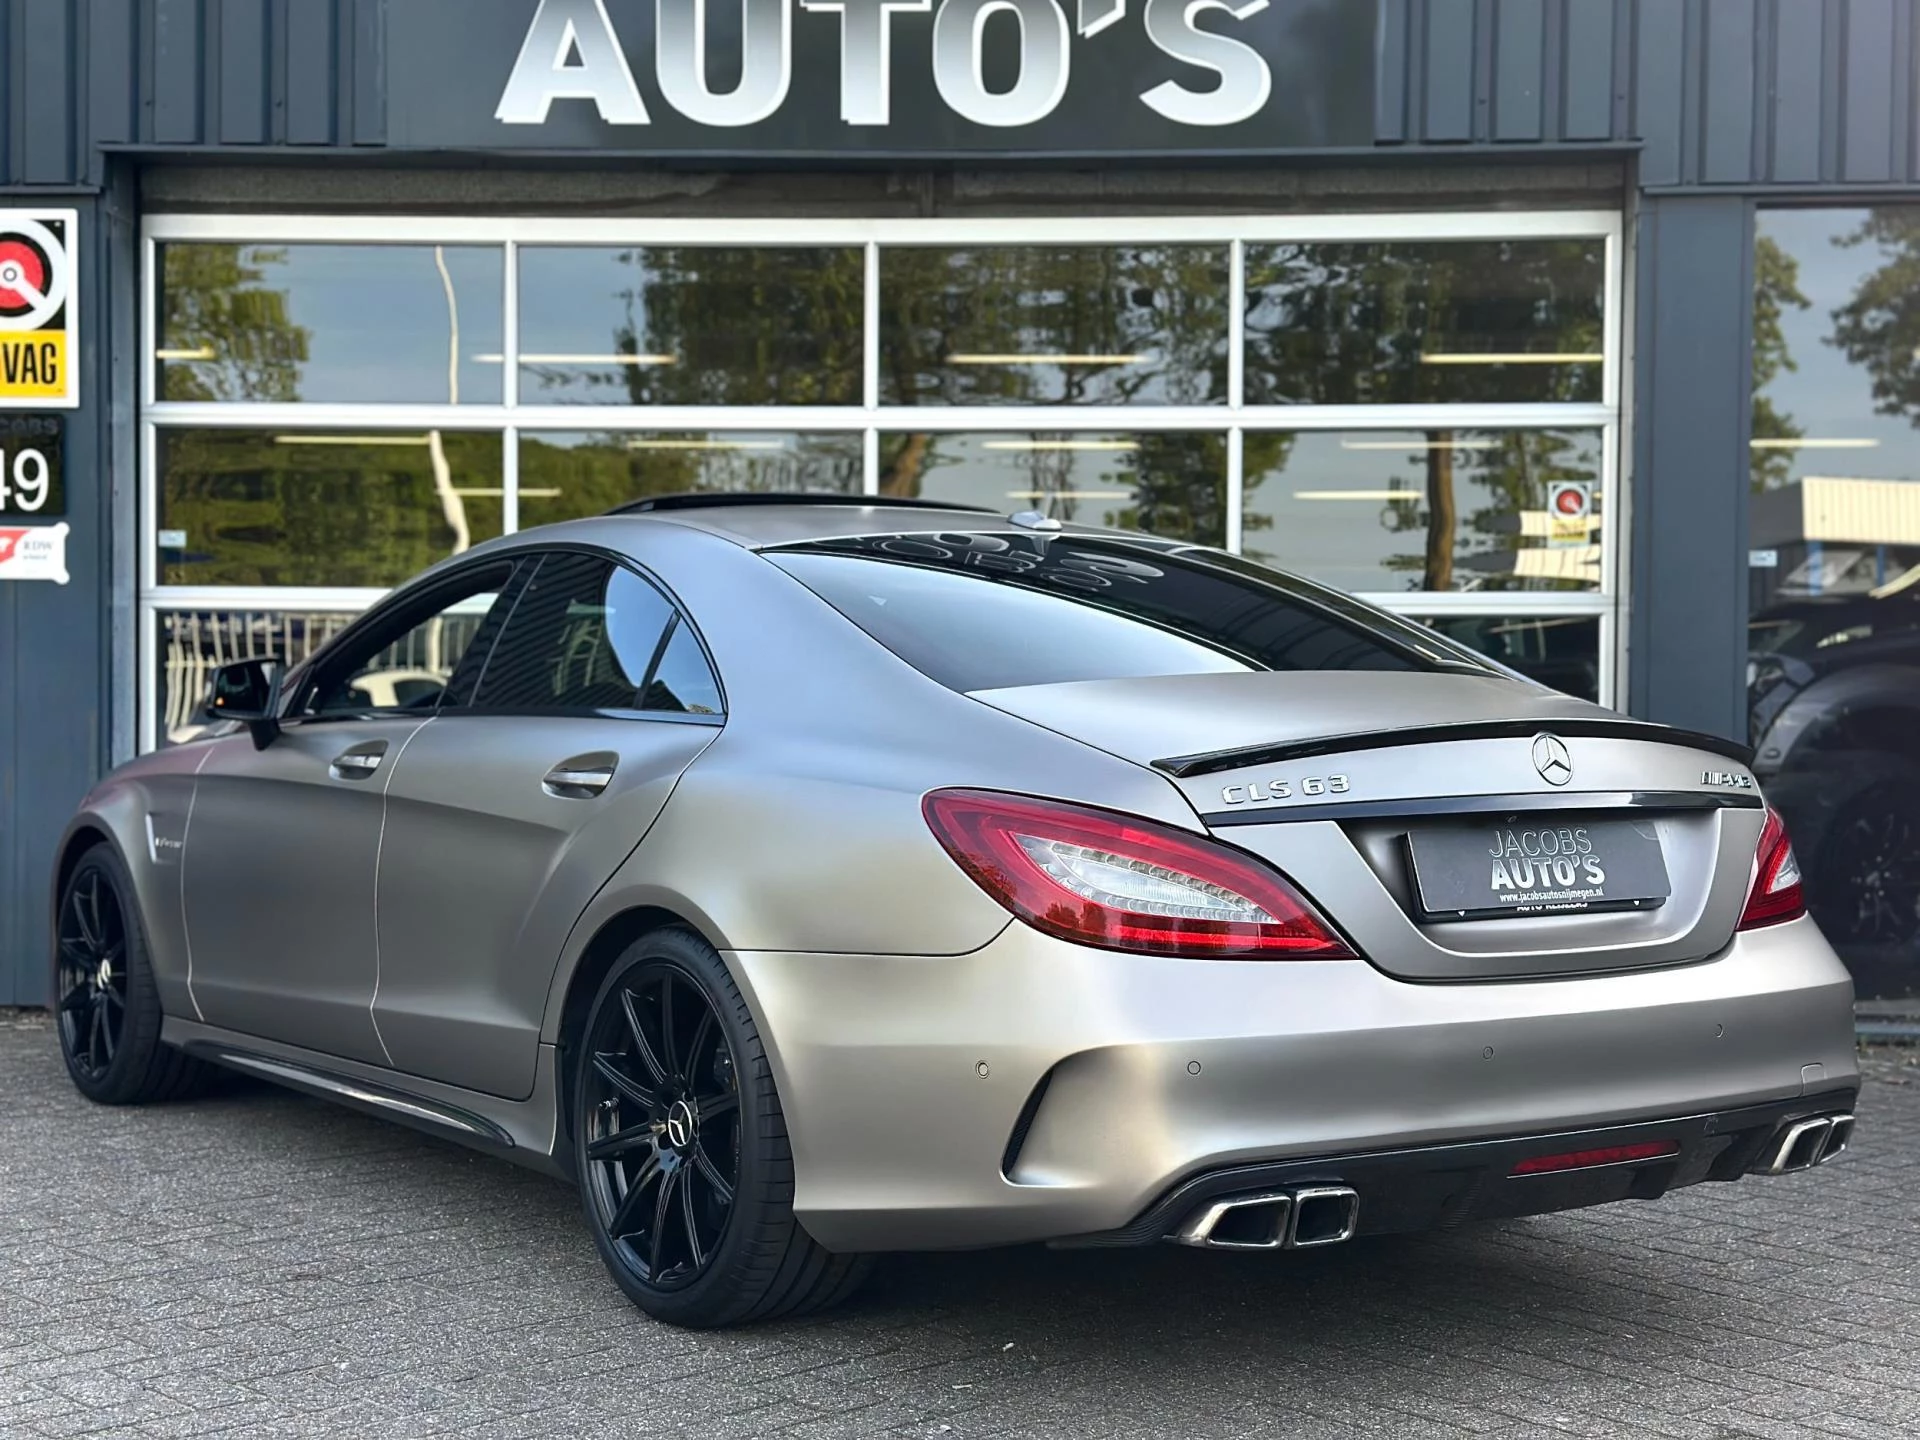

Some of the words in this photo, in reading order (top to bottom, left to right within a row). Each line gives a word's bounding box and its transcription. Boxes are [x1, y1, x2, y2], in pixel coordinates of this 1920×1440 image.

[494, 0, 1272, 127] AUTO'S
[1222, 780, 1292, 804] CLS
[1302, 774, 1350, 795] 63
[1488, 828, 1592, 858] JACOBS
[1491, 854, 1605, 890] AUTO'S
[1500, 886, 1604, 903] www.jacobsautosnijmegen.nl
